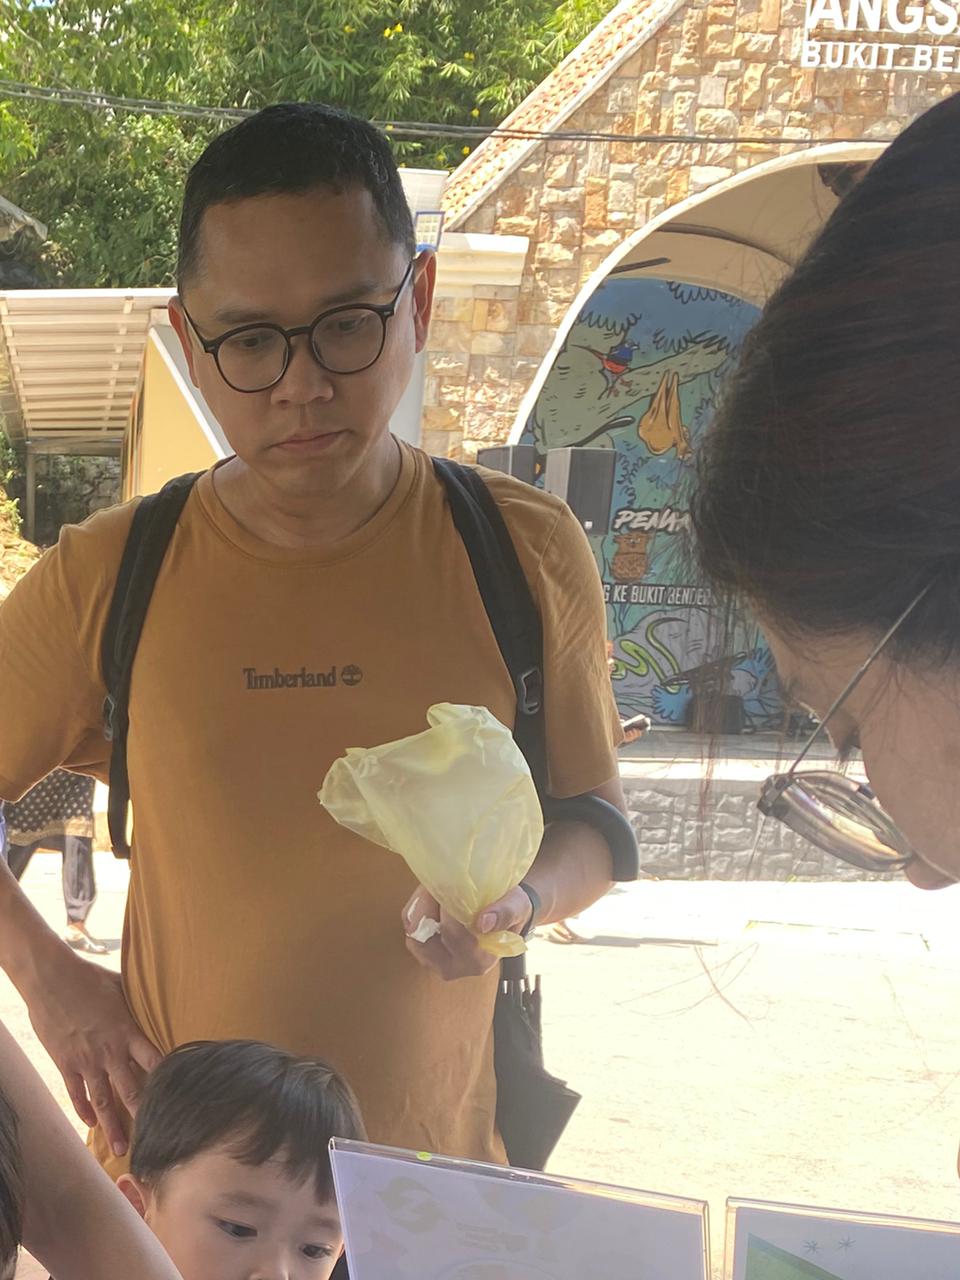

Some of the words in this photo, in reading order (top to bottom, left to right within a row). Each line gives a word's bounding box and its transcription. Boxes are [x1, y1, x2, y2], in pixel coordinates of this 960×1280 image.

[801, 40, 900, 69] BUKIT
[613, 585, 629, 602] KE
[631, 585, 665, 604] BUKIT
[243, 666, 337, 689] Timberland
